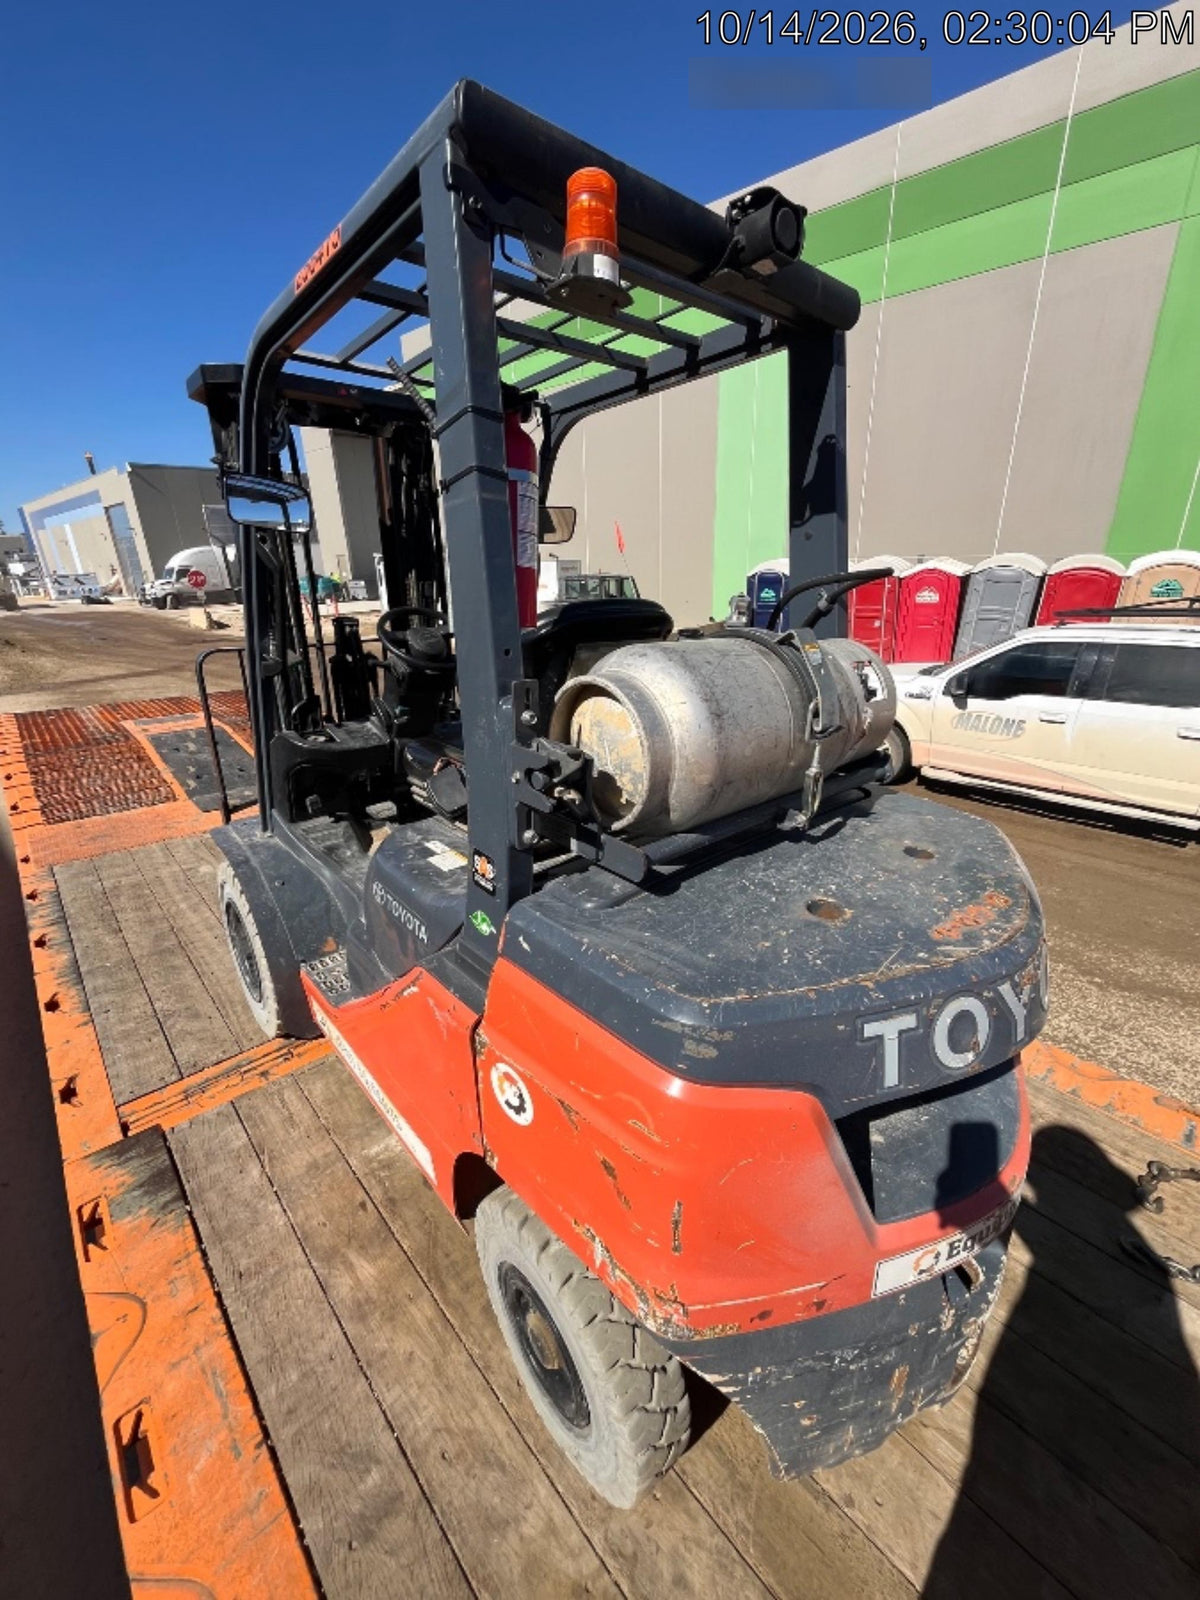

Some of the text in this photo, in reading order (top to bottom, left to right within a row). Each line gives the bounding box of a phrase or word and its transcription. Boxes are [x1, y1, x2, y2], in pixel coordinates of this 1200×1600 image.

[954, 712, 1027, 738] MALONE
[385, 893, 429, 944] TOYOTA
[863, 945, 1049, 1089] TOY
